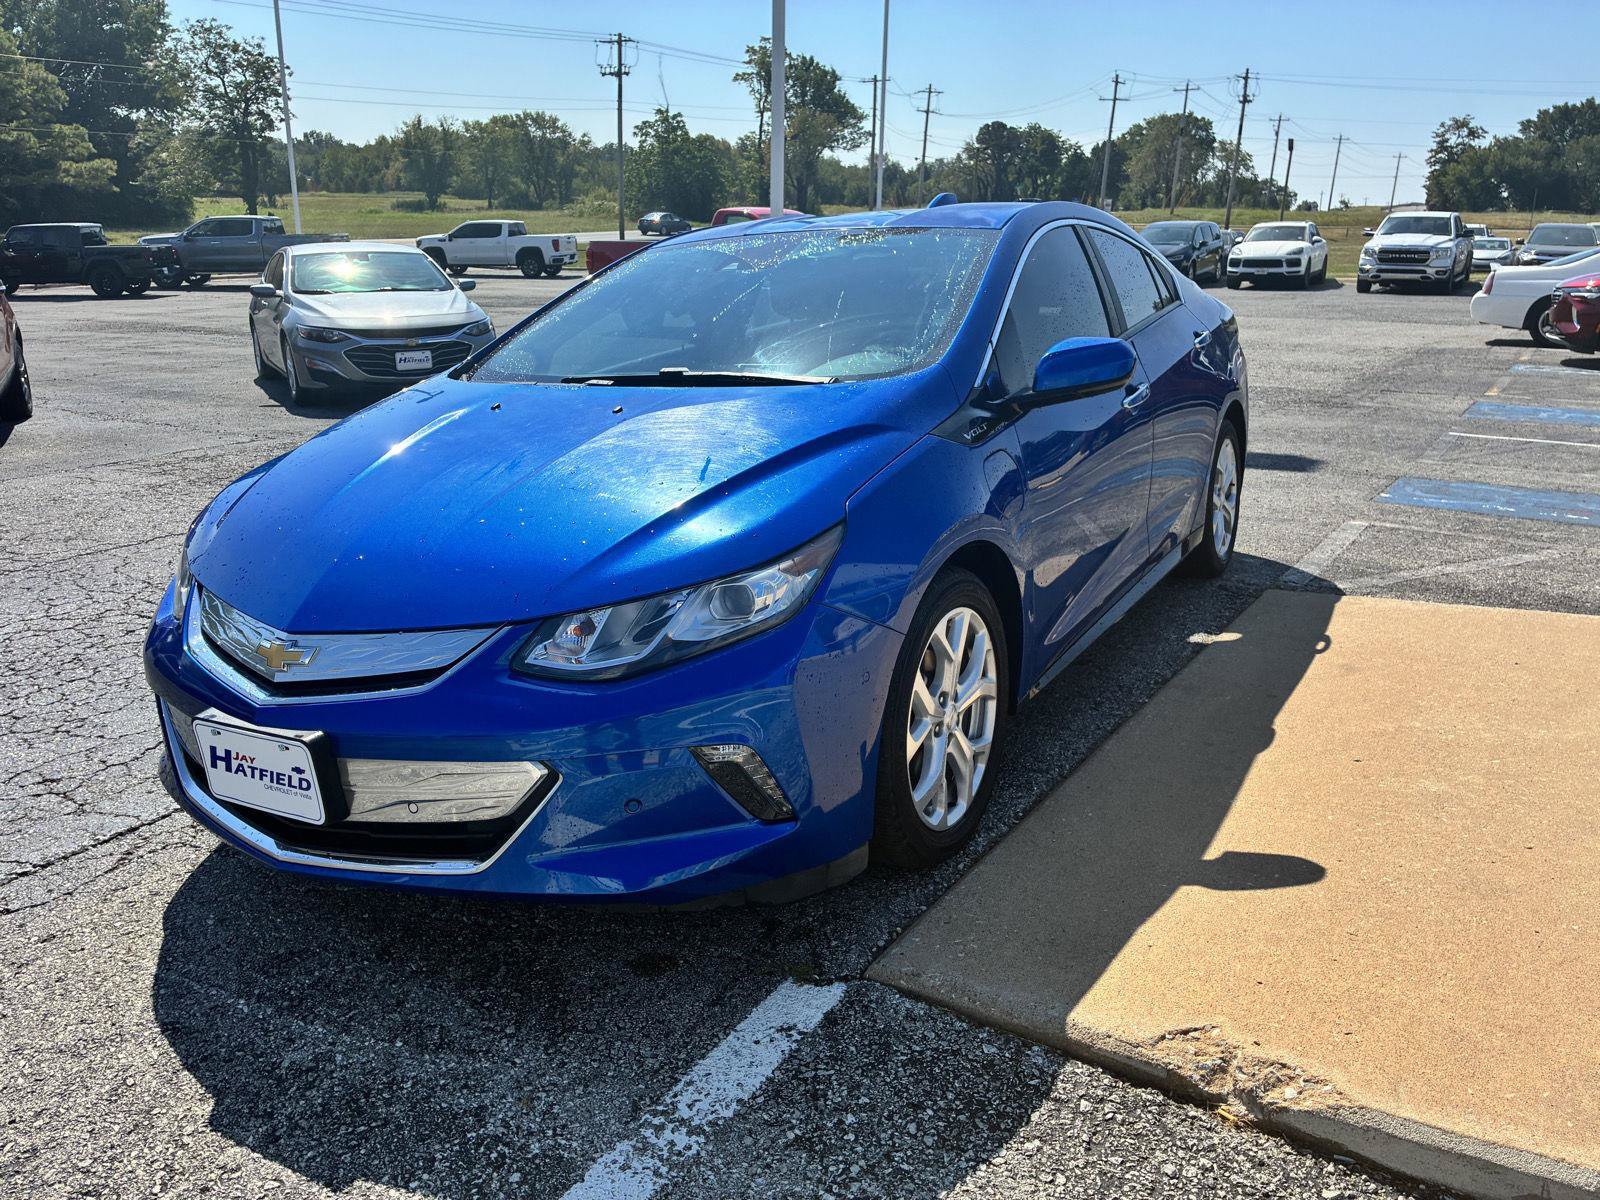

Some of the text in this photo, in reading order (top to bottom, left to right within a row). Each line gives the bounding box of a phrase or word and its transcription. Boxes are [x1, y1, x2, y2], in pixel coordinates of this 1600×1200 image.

[963, 422, 988, 440] VOLT
[233, 751, 256, 765] JAY
[209, 745, 312, 792] HATFIELD
